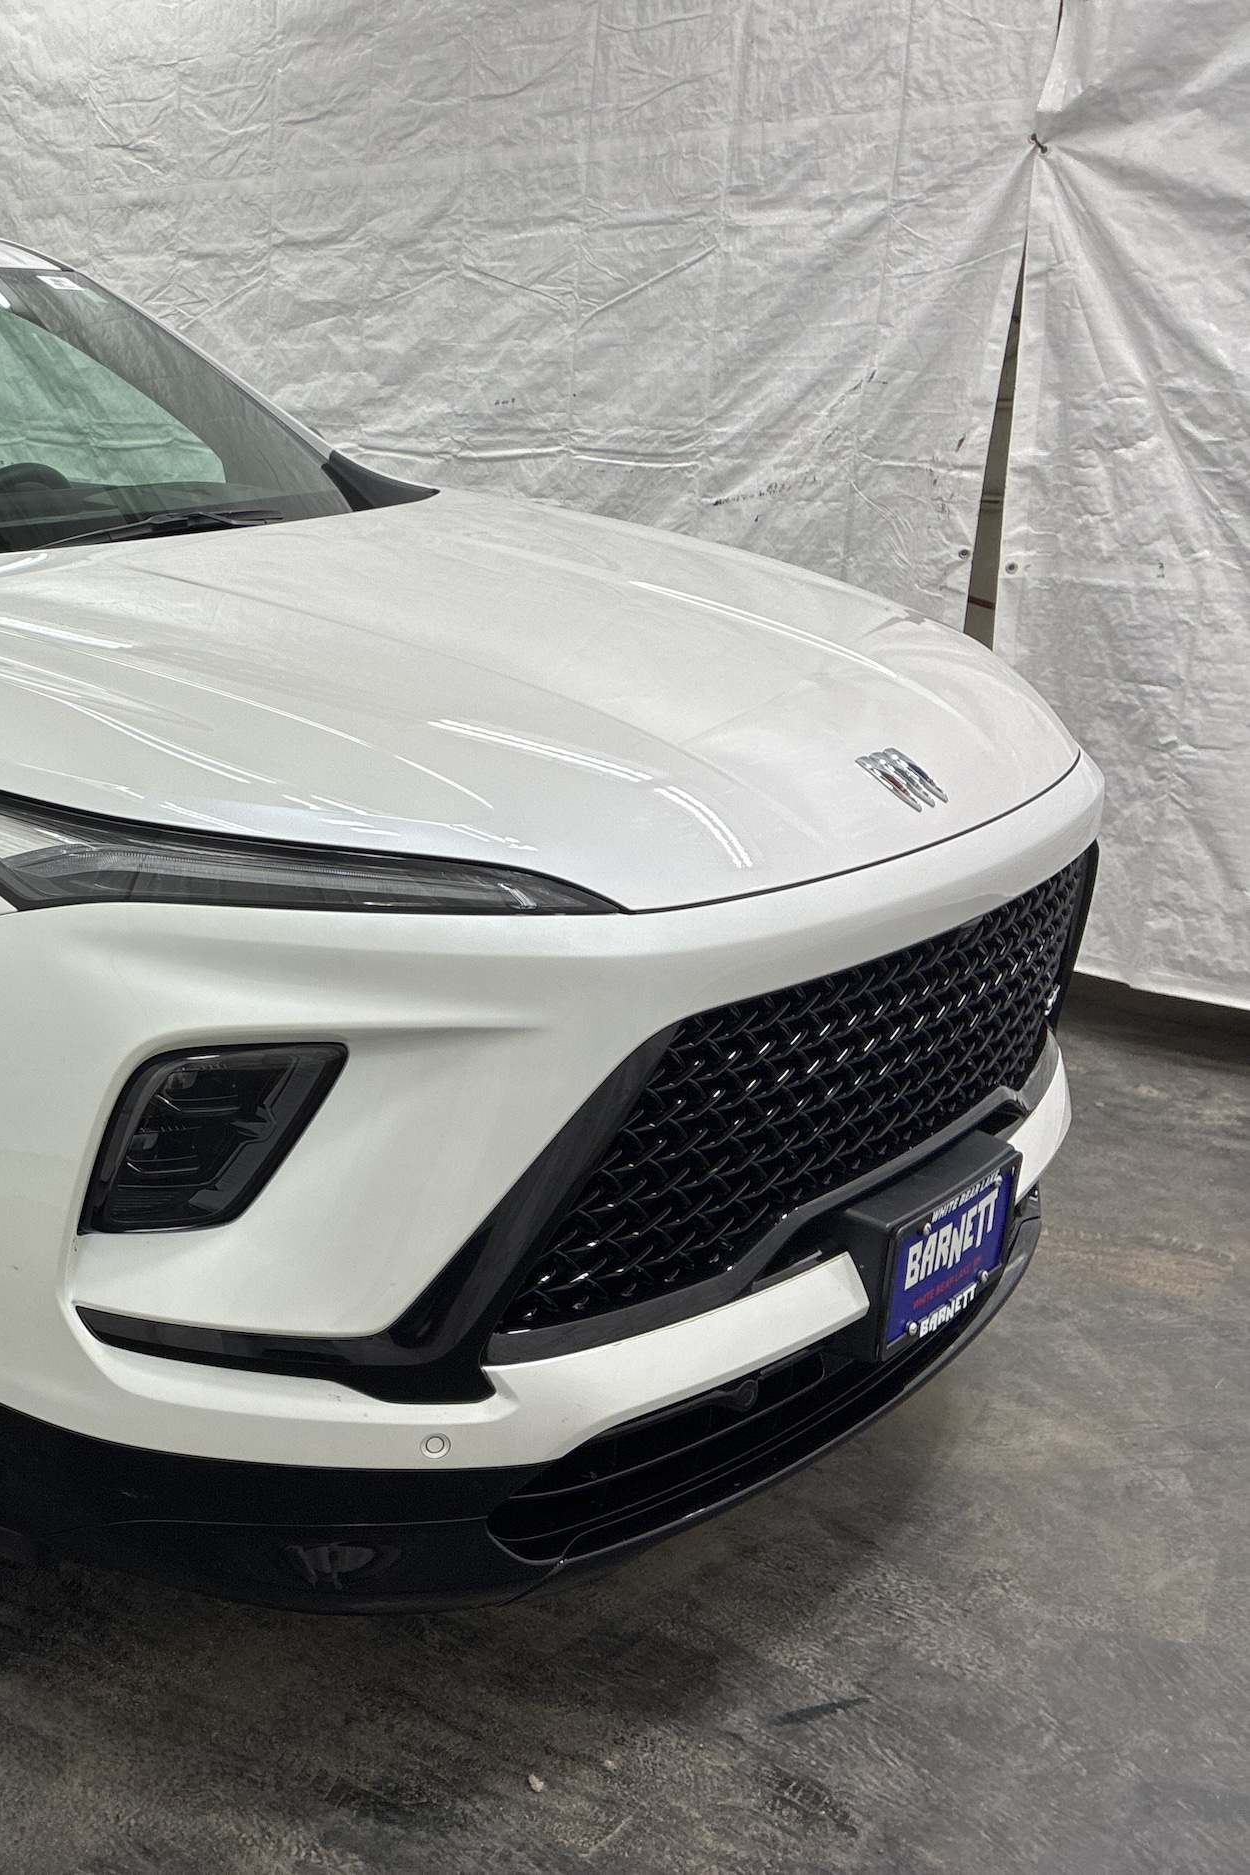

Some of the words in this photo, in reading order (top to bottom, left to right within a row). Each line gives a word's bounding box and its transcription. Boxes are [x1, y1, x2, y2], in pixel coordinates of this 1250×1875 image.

[931, 1196, 960, 1224] WHITE
[904, 1187, 999, 1291] BARNETT
[918, 1282, 978, 1338] BARNETT
